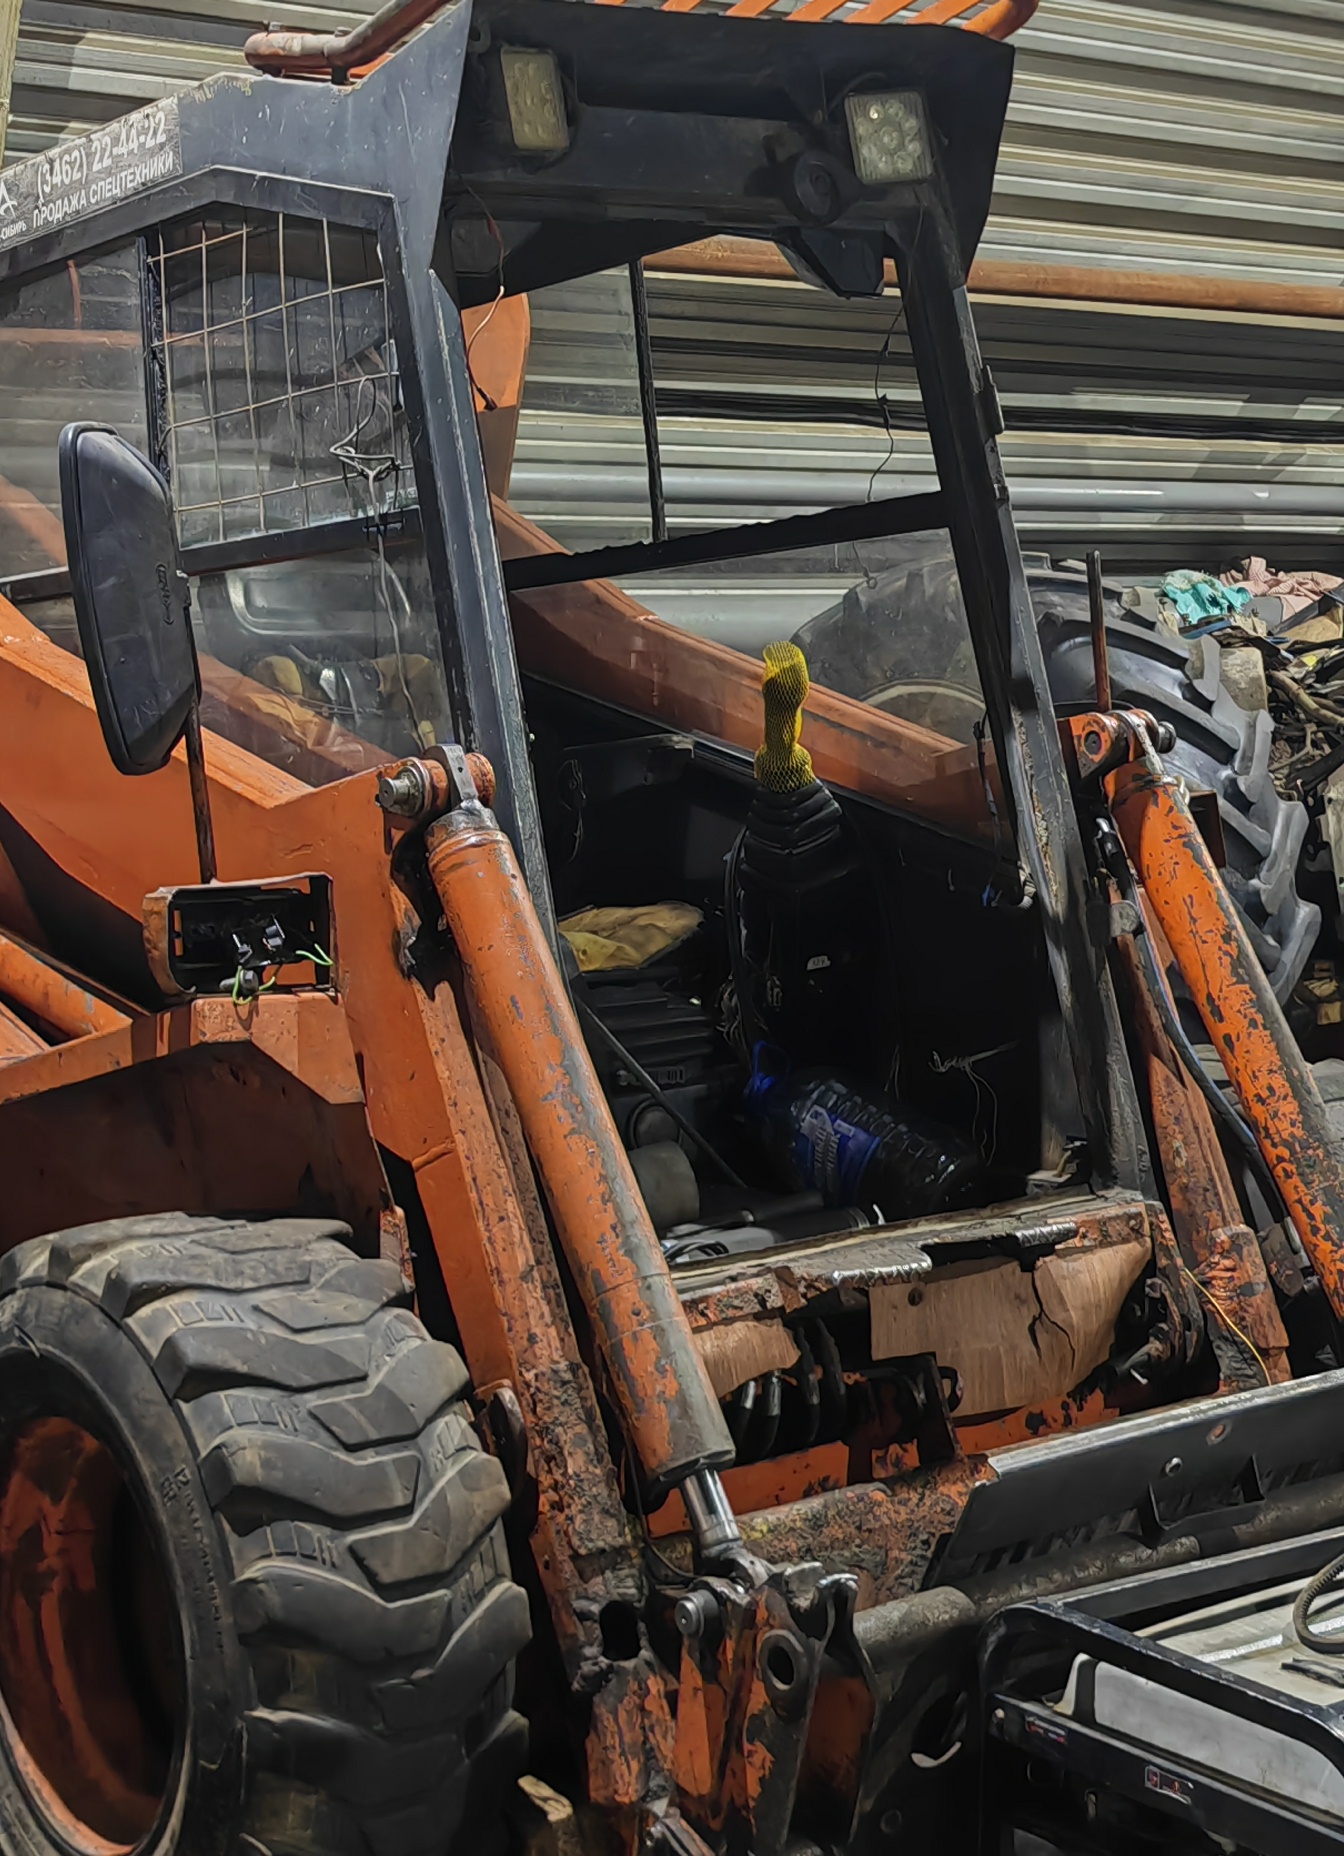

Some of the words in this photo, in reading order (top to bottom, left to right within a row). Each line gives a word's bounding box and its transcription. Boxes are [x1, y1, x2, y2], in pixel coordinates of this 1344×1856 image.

[32, 189, 87, 229] ПРОДАЖА
[89, 151, 174, 204] СПЕЦТЕХНИКИ
[37, 146, 87, 203] (3462)
[92, 111, 168, 172] 22-44-22
